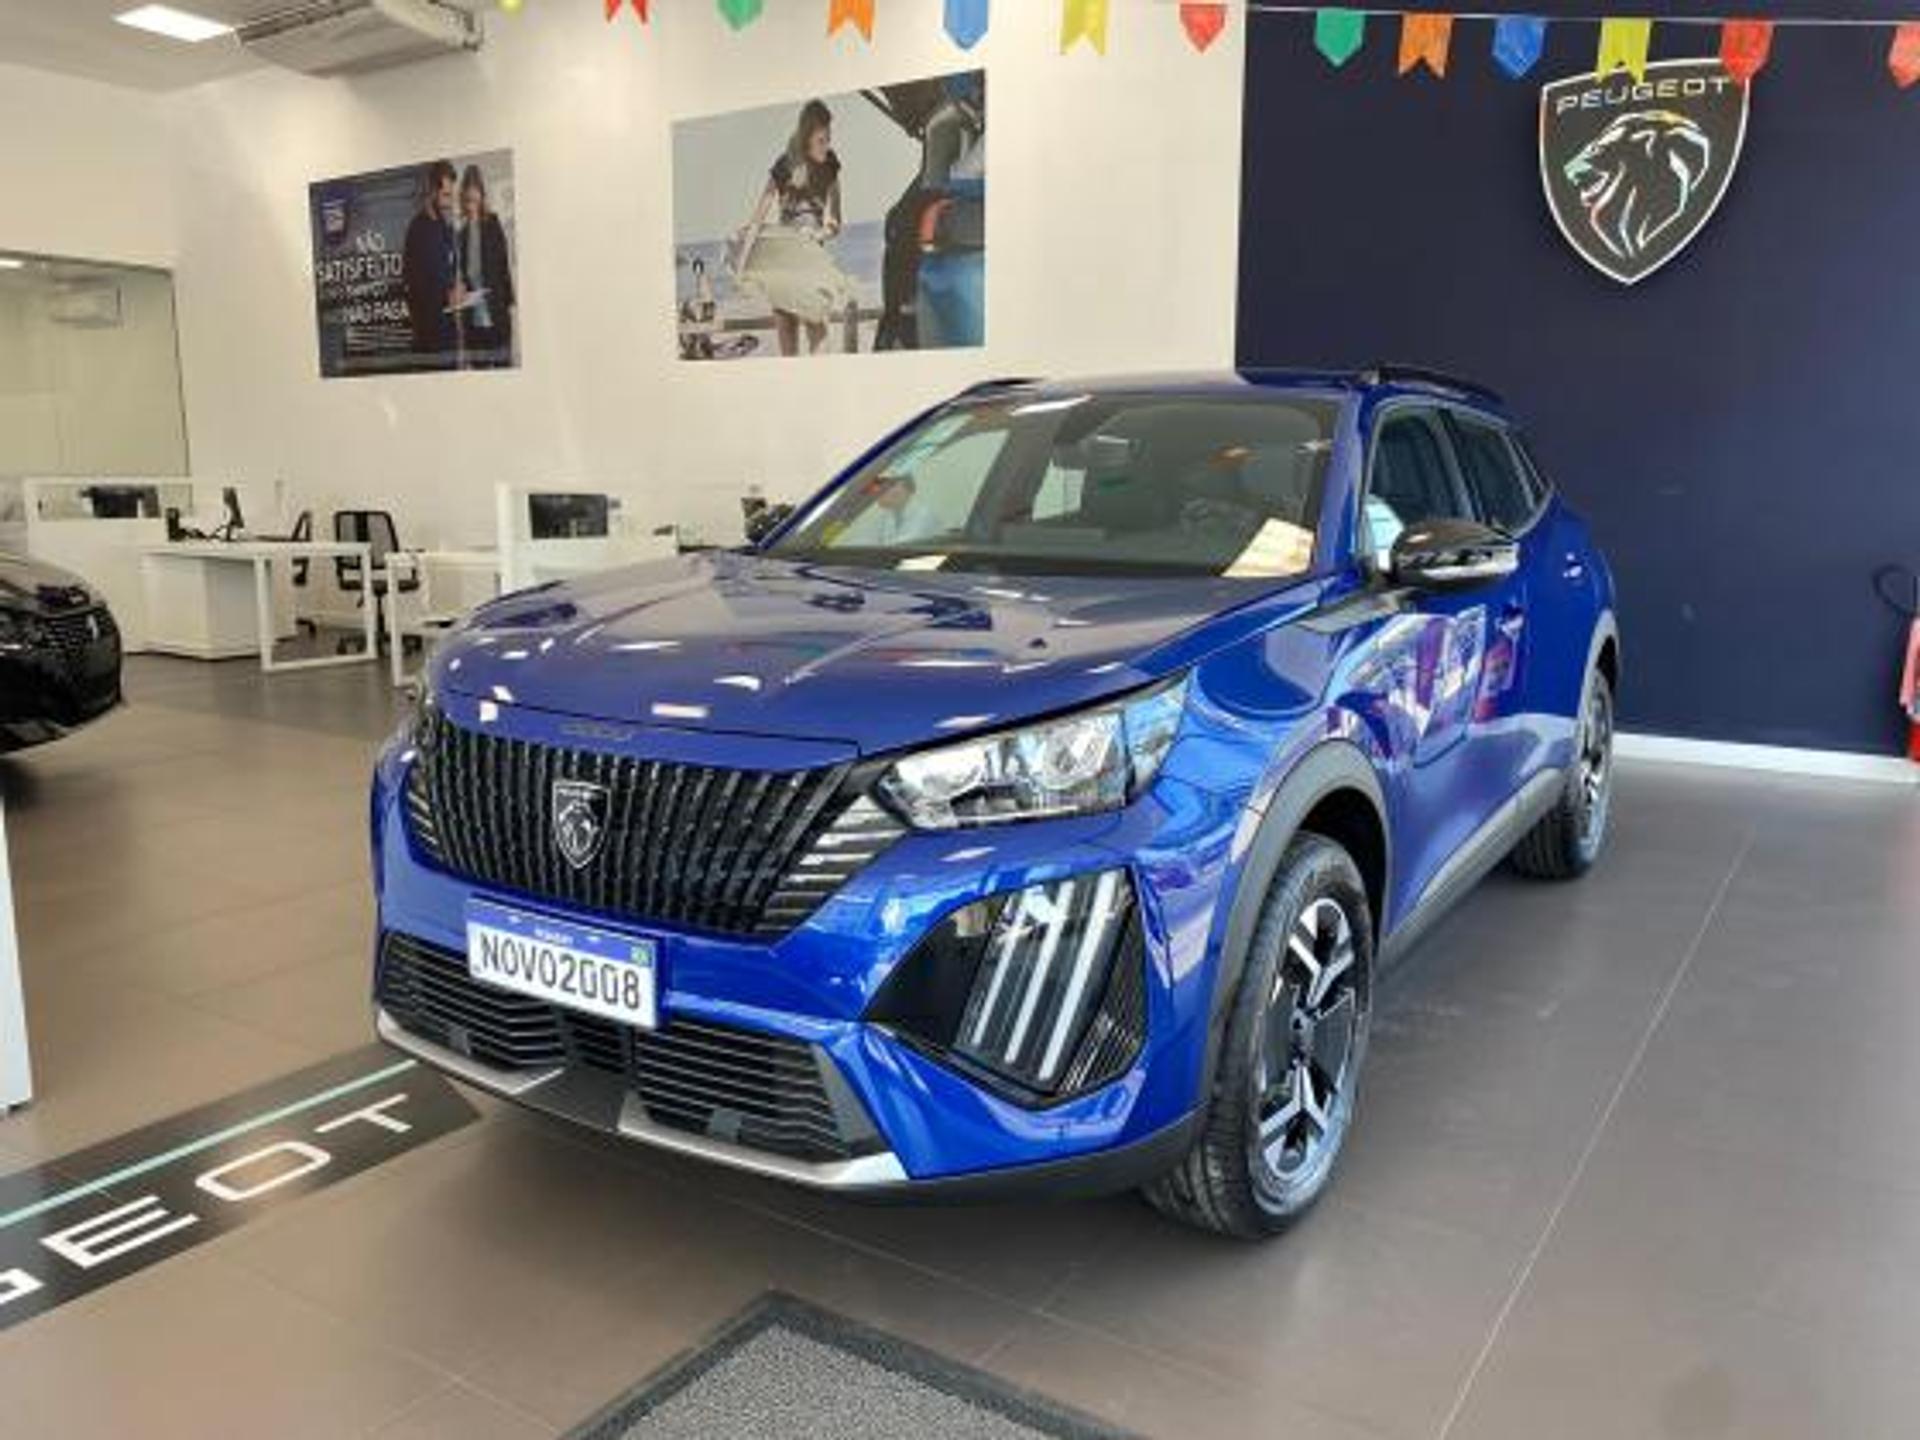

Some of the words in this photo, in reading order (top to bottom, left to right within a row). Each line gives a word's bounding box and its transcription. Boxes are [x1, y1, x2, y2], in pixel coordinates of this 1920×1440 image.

[1556, 77, 1730, 114] PEUGEOT
[373, 300, 410, 321] PAGA
[480, 932, 640, 1010] NOVO2008
[0, 1093, 413, 1300] EOT
